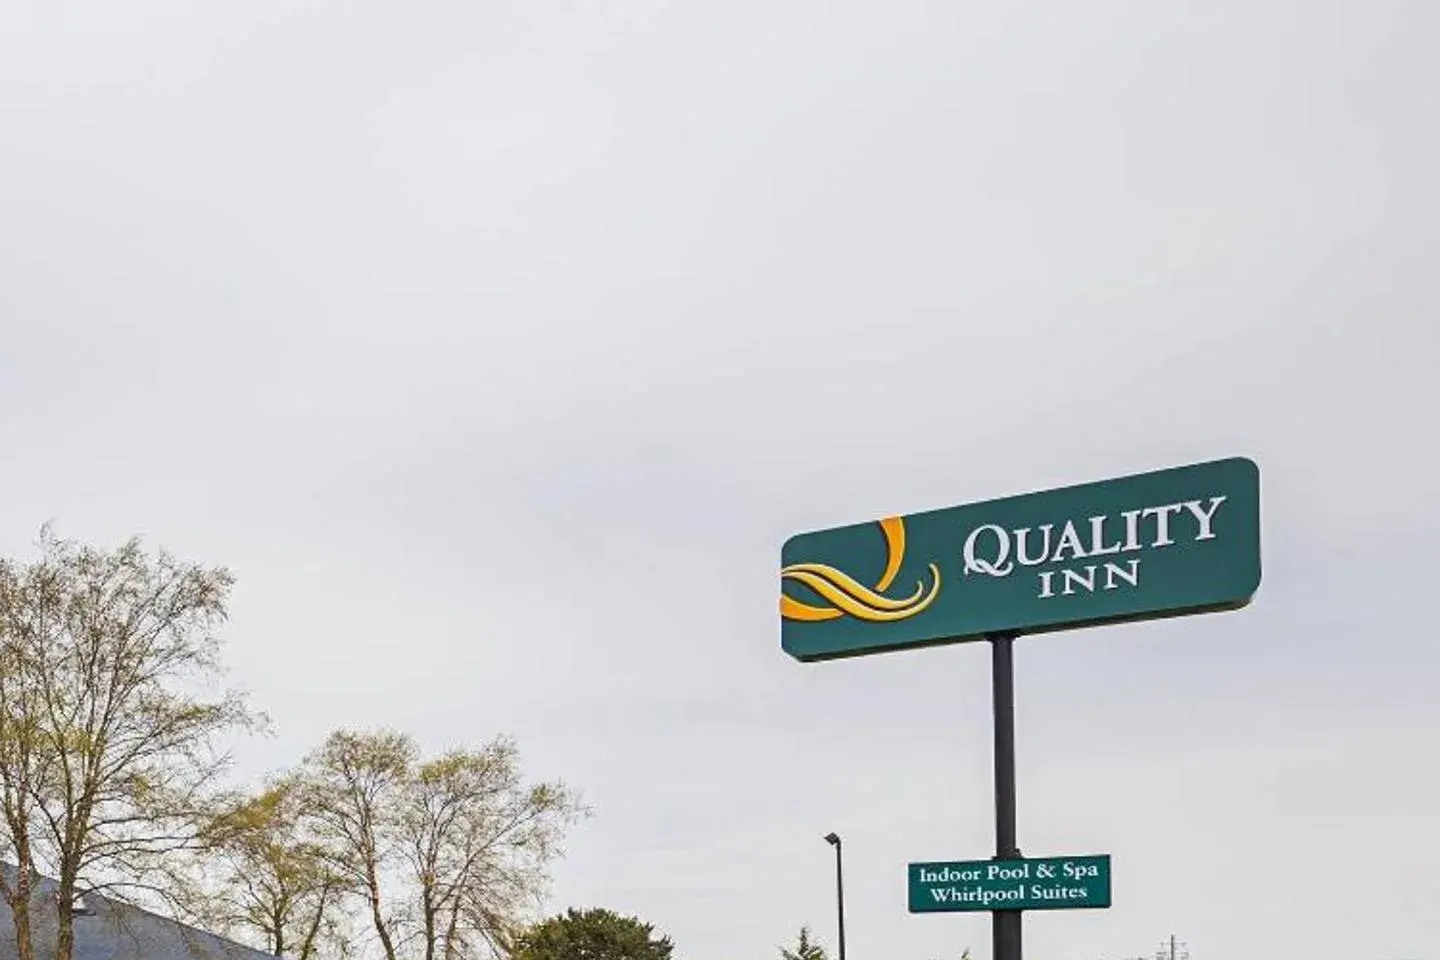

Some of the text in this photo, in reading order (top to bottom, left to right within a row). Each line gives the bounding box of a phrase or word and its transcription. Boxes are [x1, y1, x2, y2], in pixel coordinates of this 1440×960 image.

[963, 496, 1227, 577] QUALITY
[1037, 560, 1141, 598] INN
[920, 862, 1098, 882] Indoor Pool & Spa
[930, 883, 1088, 905] Whirlpool Suites
